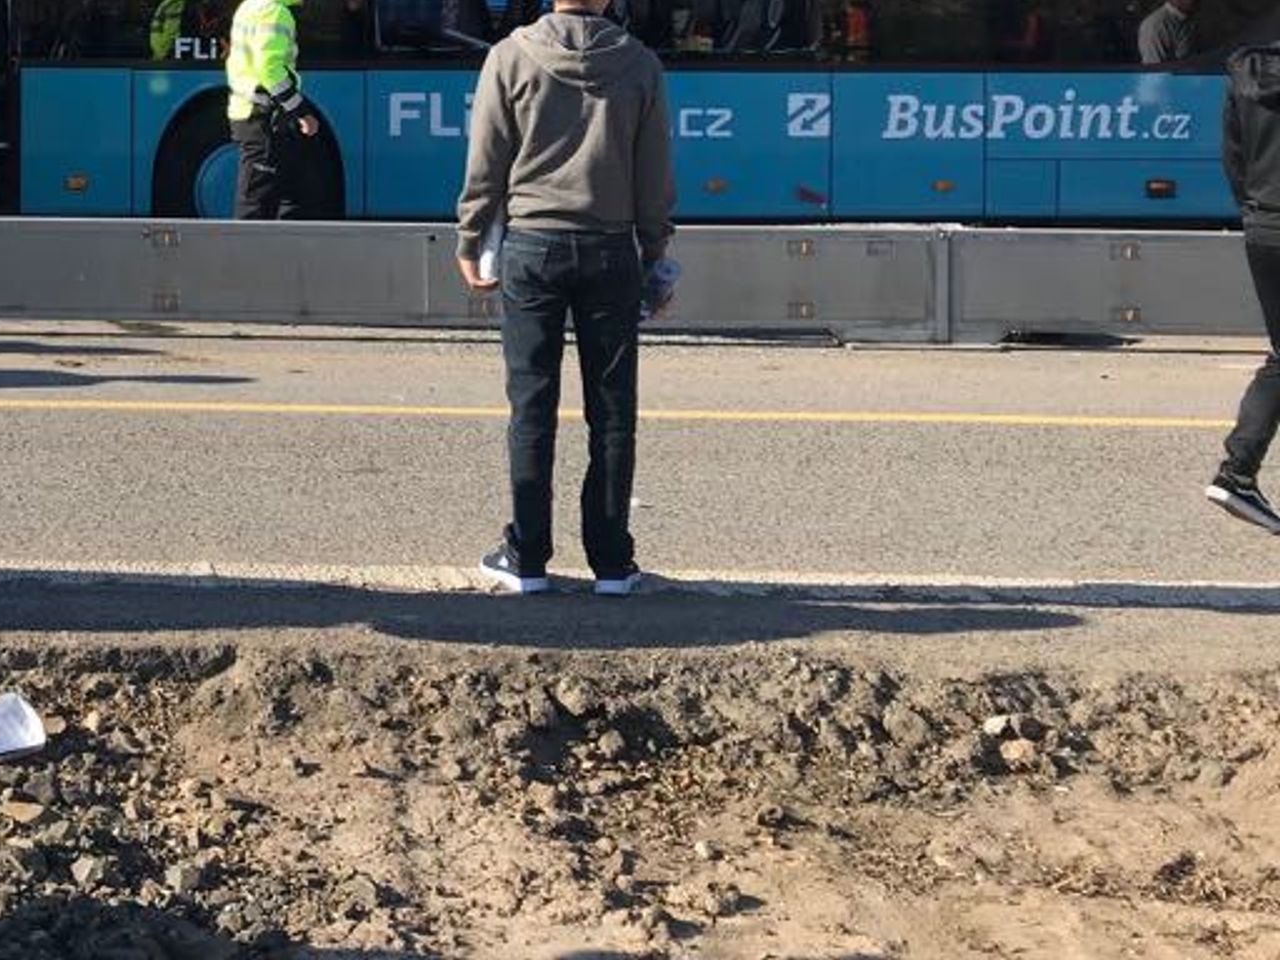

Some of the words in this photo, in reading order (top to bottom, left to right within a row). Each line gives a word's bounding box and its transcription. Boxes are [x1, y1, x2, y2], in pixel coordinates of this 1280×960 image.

[174, 37, 229, 60] FLi
[389, 92, 476, 137] FLi
[669, 108, 733, 137] CZ
[881, 88, 1191, 140] BusPoint.cz
